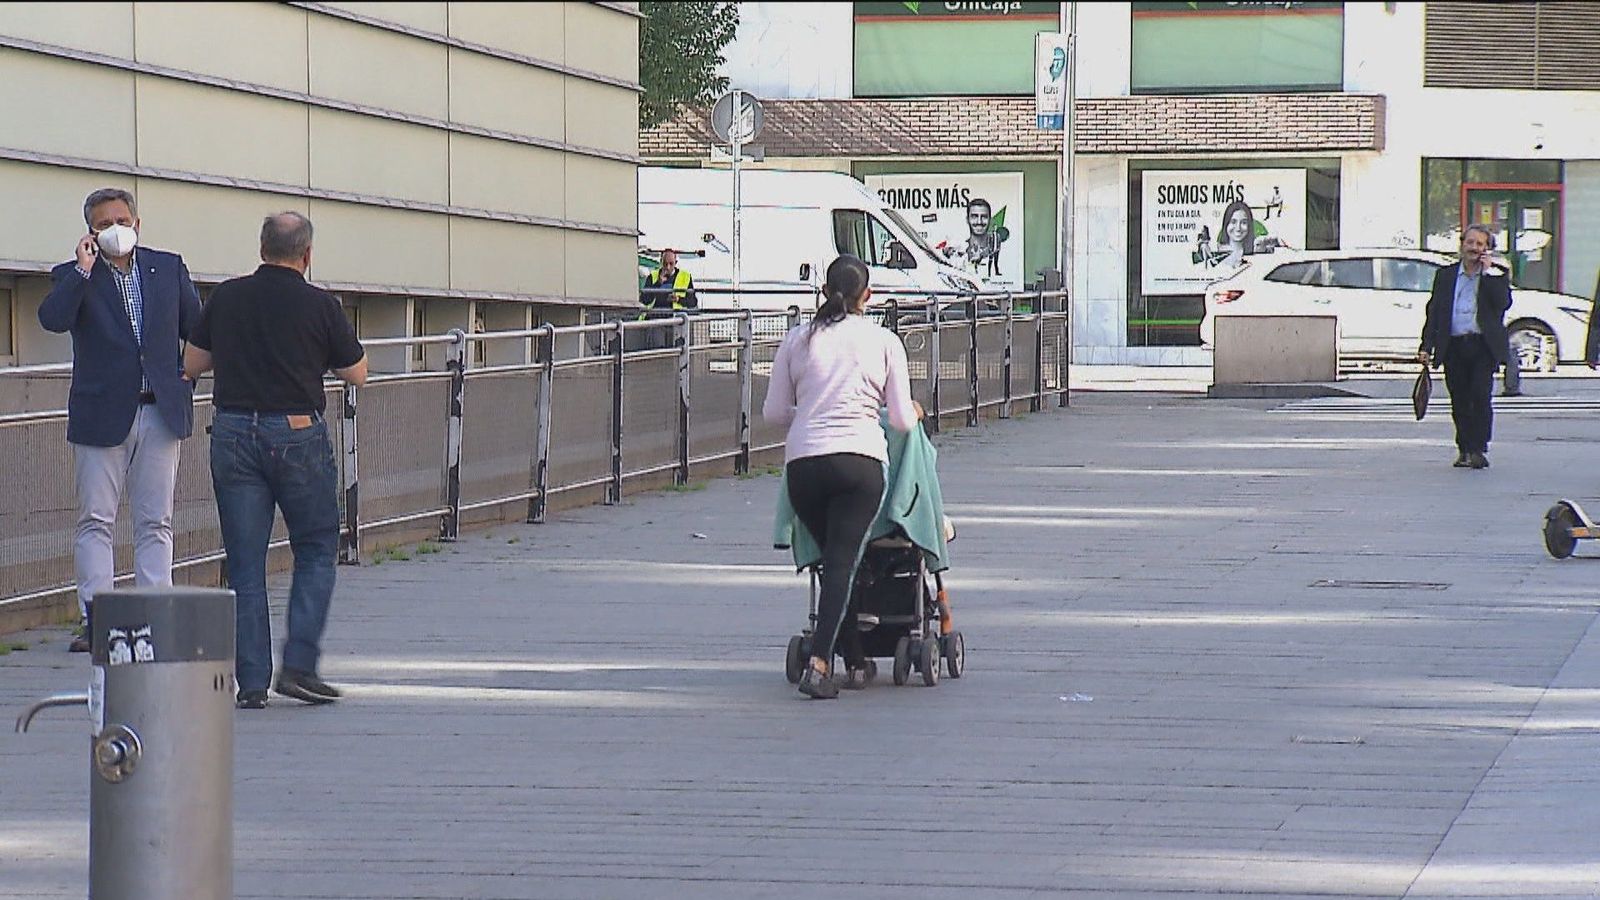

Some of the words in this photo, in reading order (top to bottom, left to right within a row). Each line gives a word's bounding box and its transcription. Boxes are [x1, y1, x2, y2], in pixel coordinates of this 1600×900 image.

[936, 183, 970, 208] MÁS
[1157, 184, 1208, 204] SOMOS
[1212, 179, 1244, 204] MÁS
